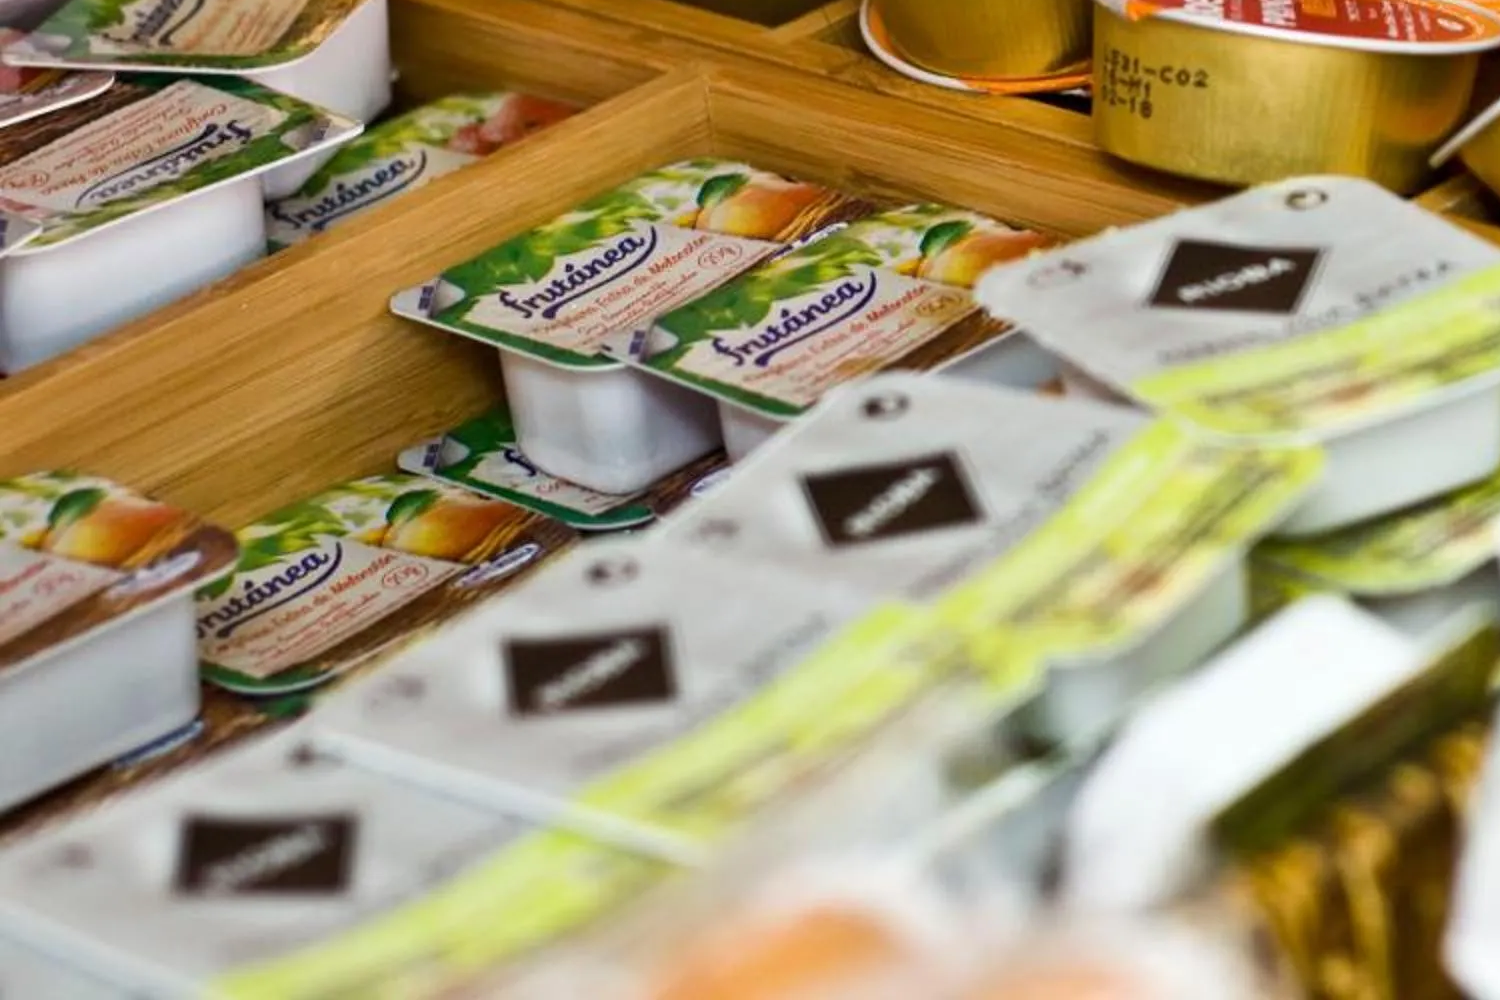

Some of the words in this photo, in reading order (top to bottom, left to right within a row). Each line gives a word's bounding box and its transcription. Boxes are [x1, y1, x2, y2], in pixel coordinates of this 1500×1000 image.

[270, 158, 415, 231] frutánea
[499, 233, 645, 319] frutánea
[713, 278, 864, 366] frutánea
